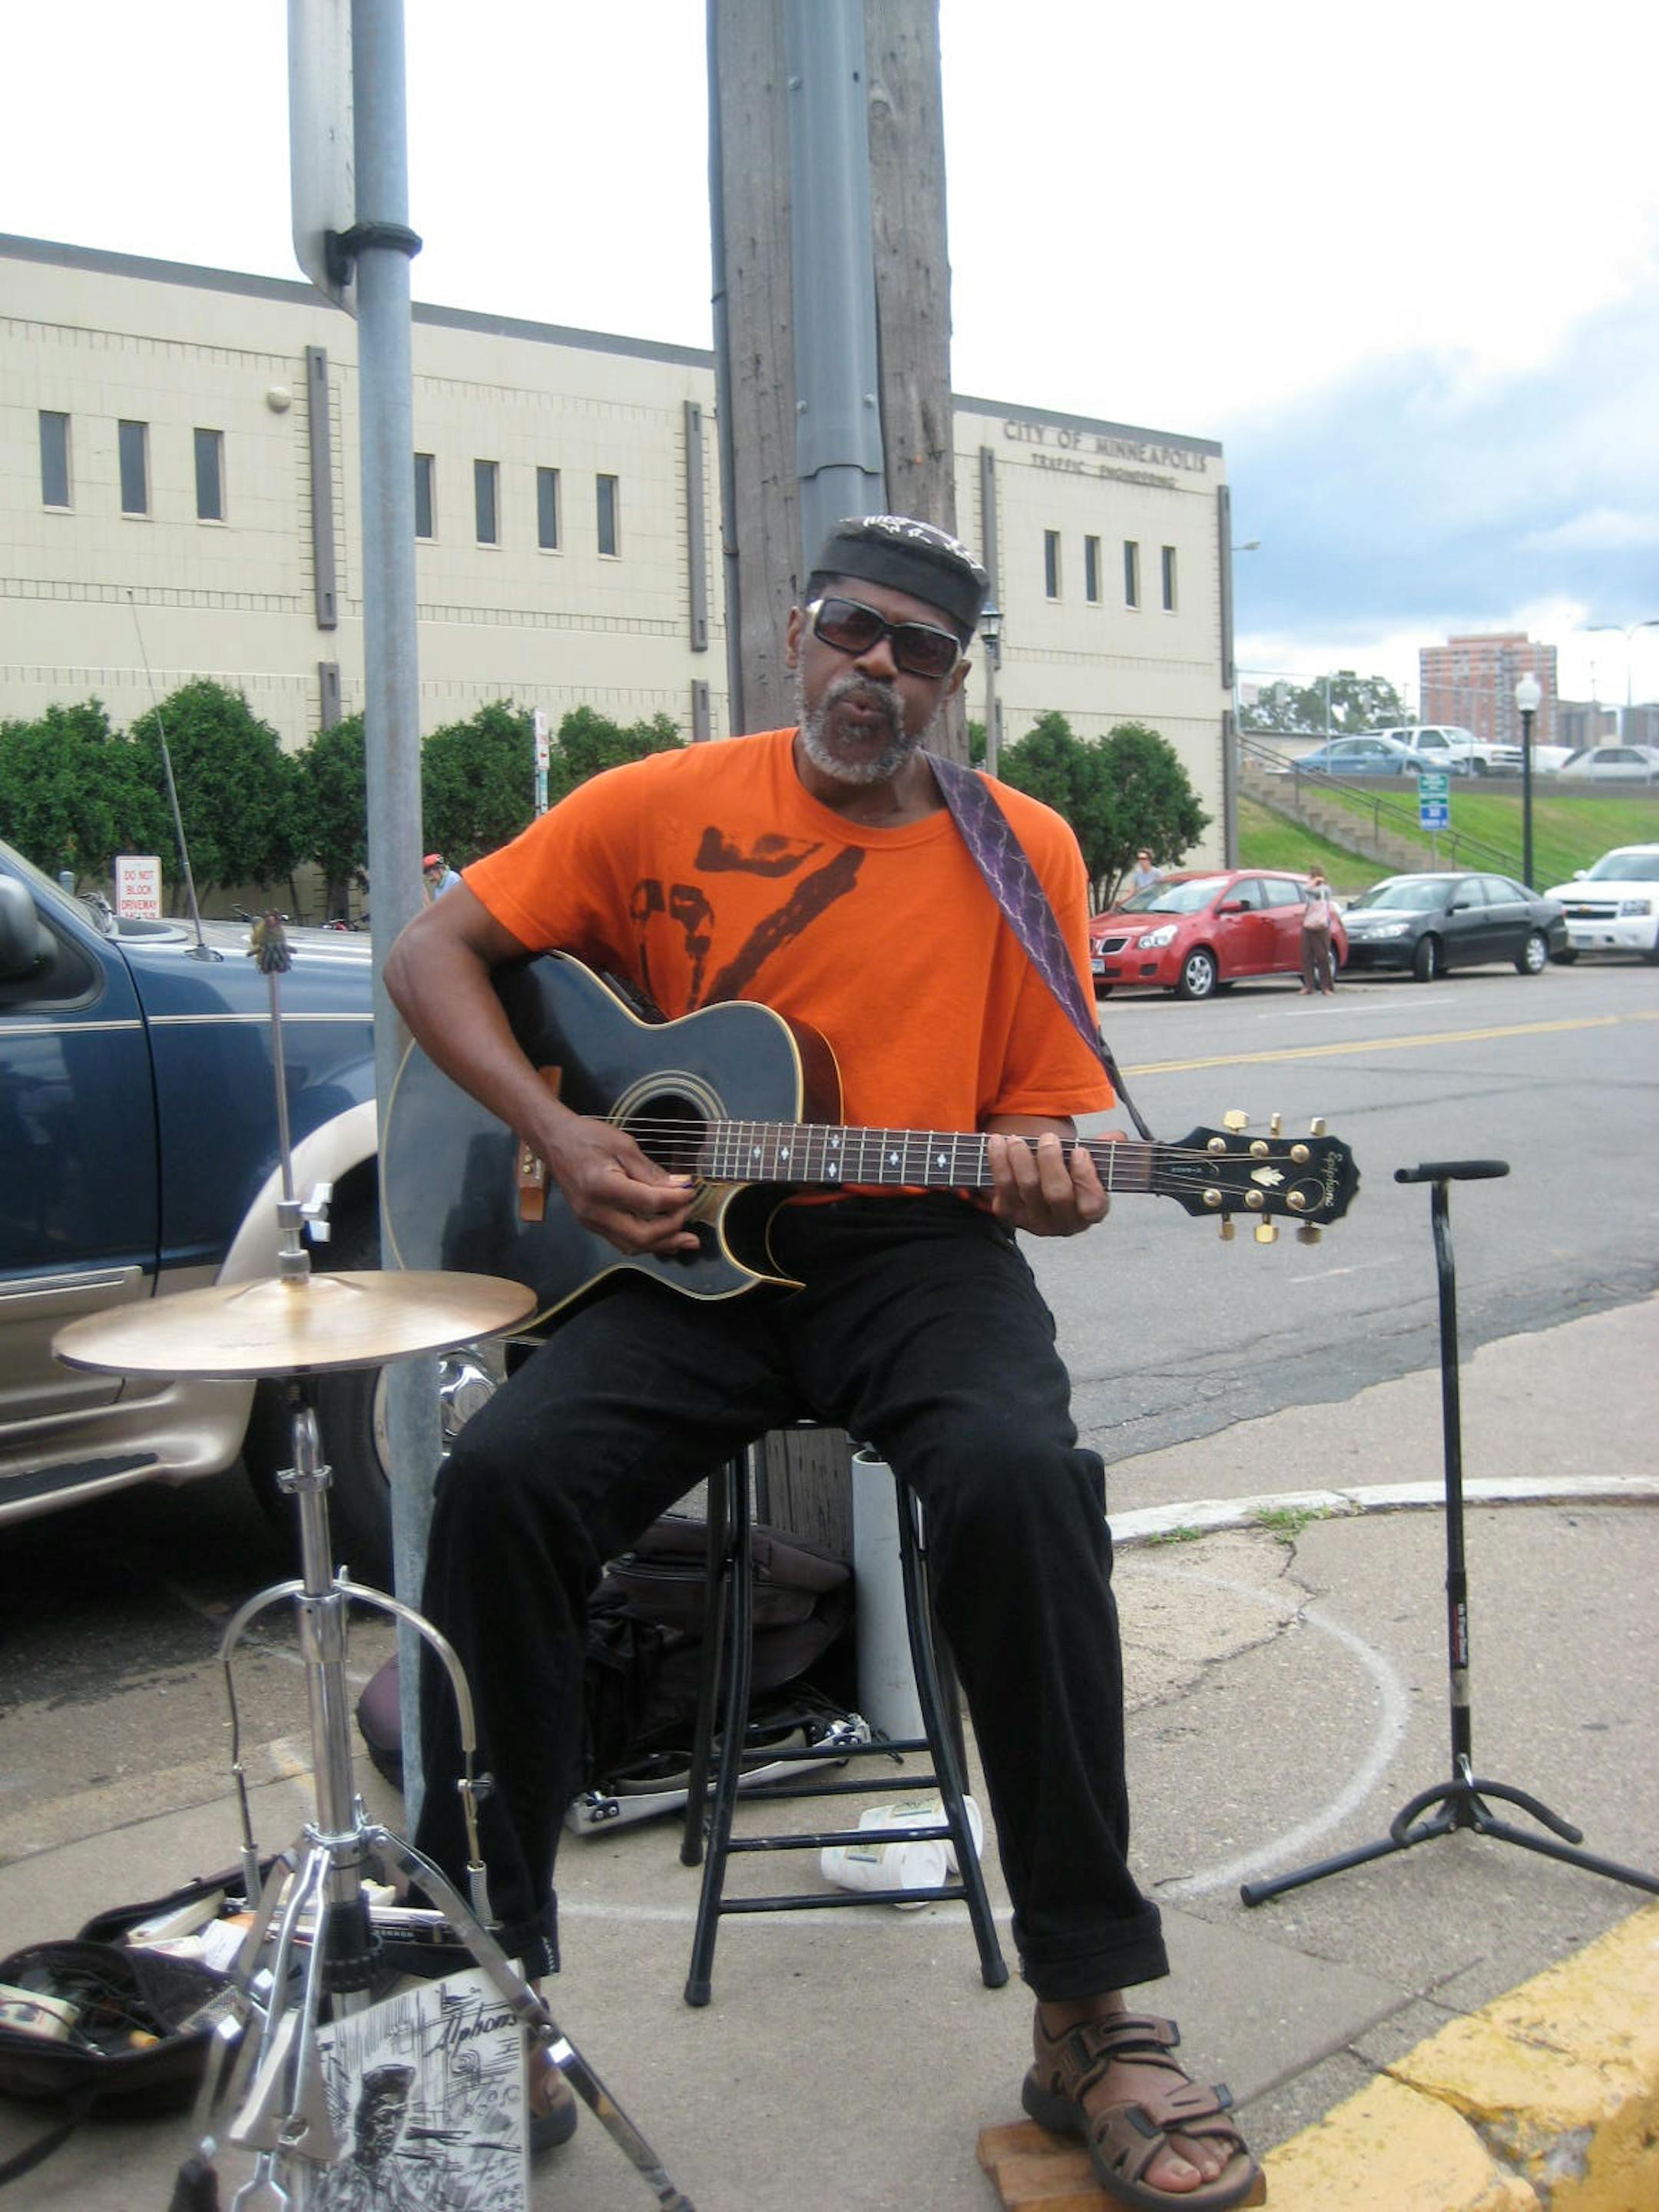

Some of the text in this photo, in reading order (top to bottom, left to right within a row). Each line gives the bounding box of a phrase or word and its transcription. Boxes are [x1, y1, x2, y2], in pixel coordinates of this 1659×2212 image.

[1004, 421, 1207, 472] CITY OF MINNEAPOLIS
[1031, 452, 1086, 475] TRAFFIC
[124, 870, 155, 880] DO NOT
[126, 884, 151, 896] BLOCK
[121, 899, 157, 911] DRIVEWAY
[1321, 1151, 1343, 1207] Epiphone
